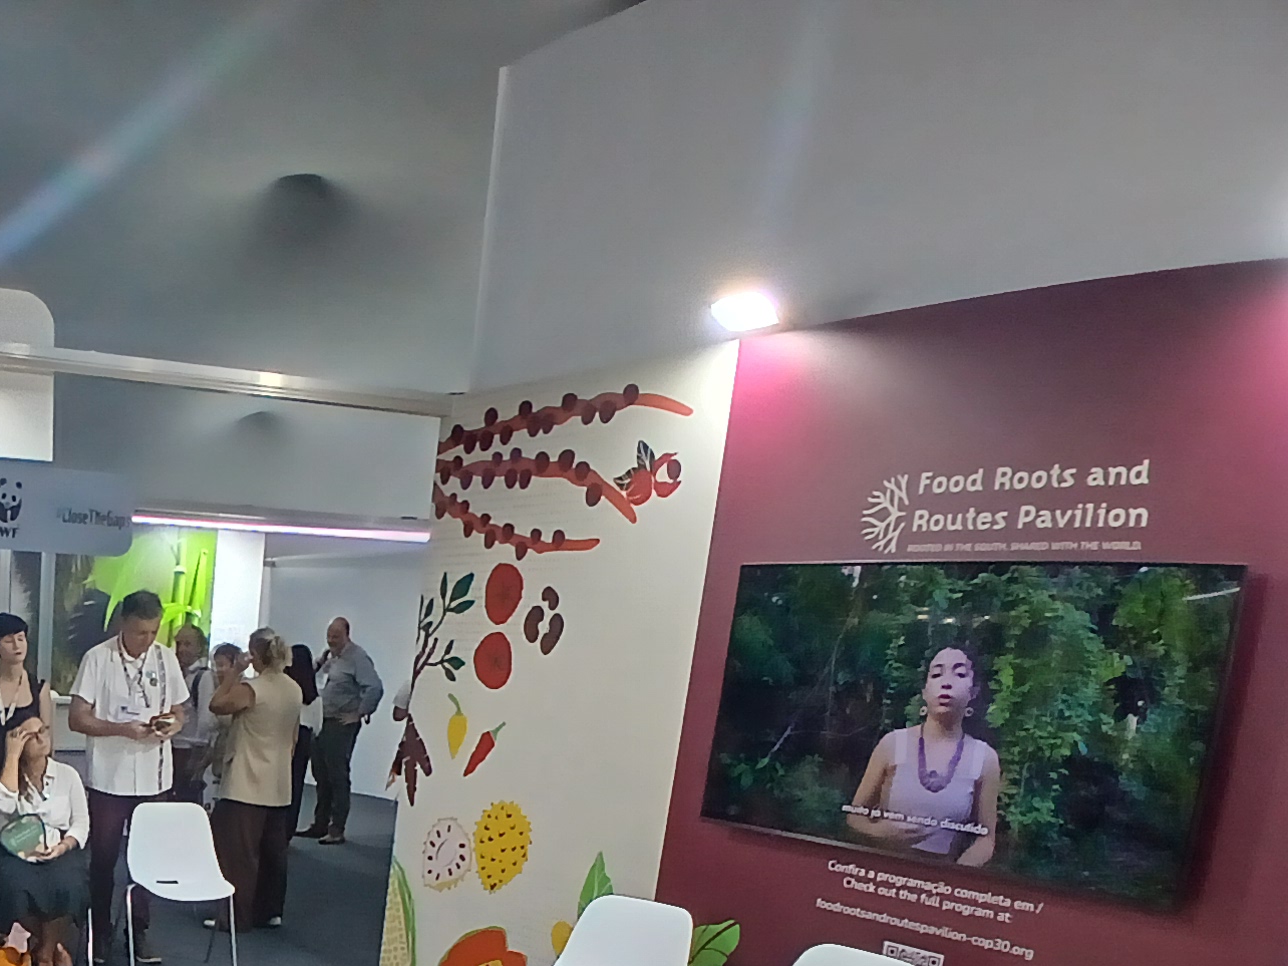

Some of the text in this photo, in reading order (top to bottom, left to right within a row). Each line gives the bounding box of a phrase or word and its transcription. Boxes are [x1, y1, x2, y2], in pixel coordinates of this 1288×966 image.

[918, 458, 1150, 495] Food Roots and
[912, 502, 1149, 532] Routes Pavilion
[1051, 541, 1078, 550] WITH
[1080, 541, 1099, 550] THE
[828, 859, 1044, 914] Confira a programação completa em /
[843, 877, 1012, 923] Check out the full program at
[816, 898, 1034, 961] foodrootsandroutespavilion-cop30.org
